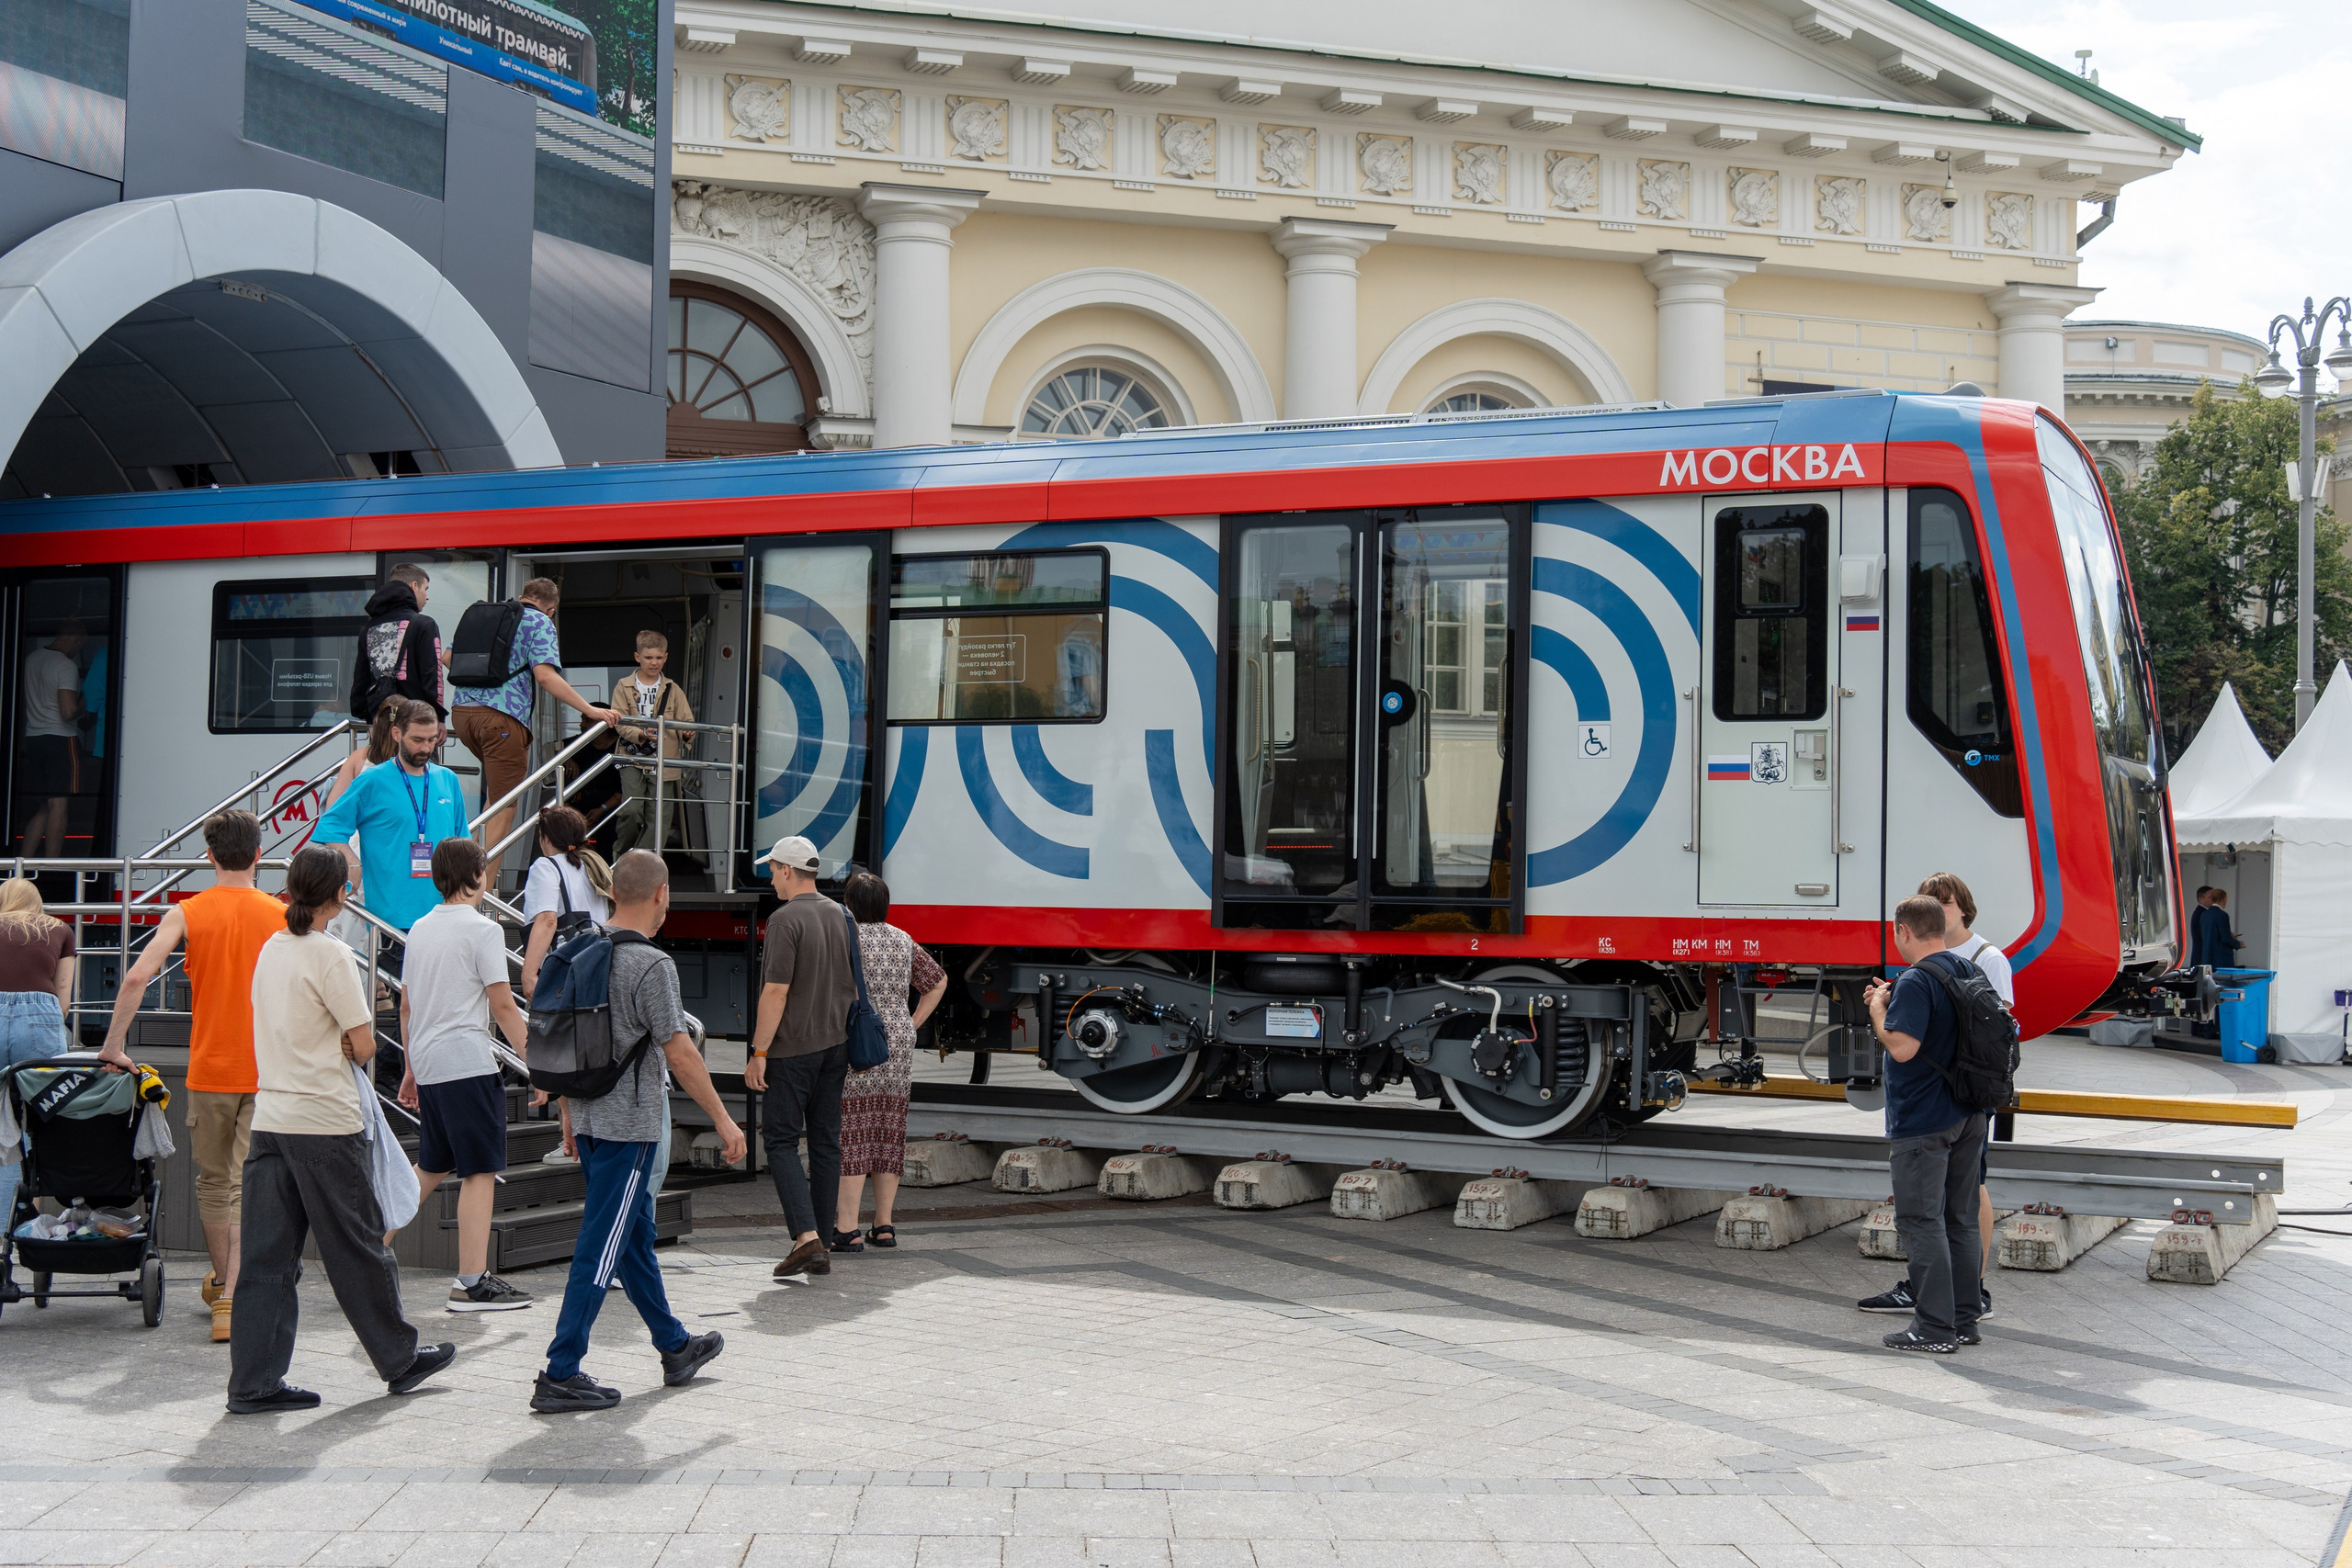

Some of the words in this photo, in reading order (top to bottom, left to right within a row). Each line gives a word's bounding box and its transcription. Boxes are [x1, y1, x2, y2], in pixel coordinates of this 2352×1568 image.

[347, 0, 386, 20] современный
[391, 17, 407, 28] мире
[397, 0, 492, 39] илотный
[495, 25, 572, 71] трамвай.
[438, 36, 473, 56] Уникальный
[499, 57, 512, 69] Едет
[527, 69, 550, 84] водитель
[550, 78, 583, 96] контролирует
[1659, 444, 1865, 486] МОСКВА
[1471, 939, 1479, 951] 2
[1599, 937, 1611, 947] КС
[1672, 939, 1689, 949] НМ
[1691, 939, 1708, 950] КМ
[1714, 939, 1731, 950] НМ
[1743, 940, 1759, 950] ТМ
[39, 1073, 87, 1112] MAFIA
[1873, 1213, 1894, 1226] 159
